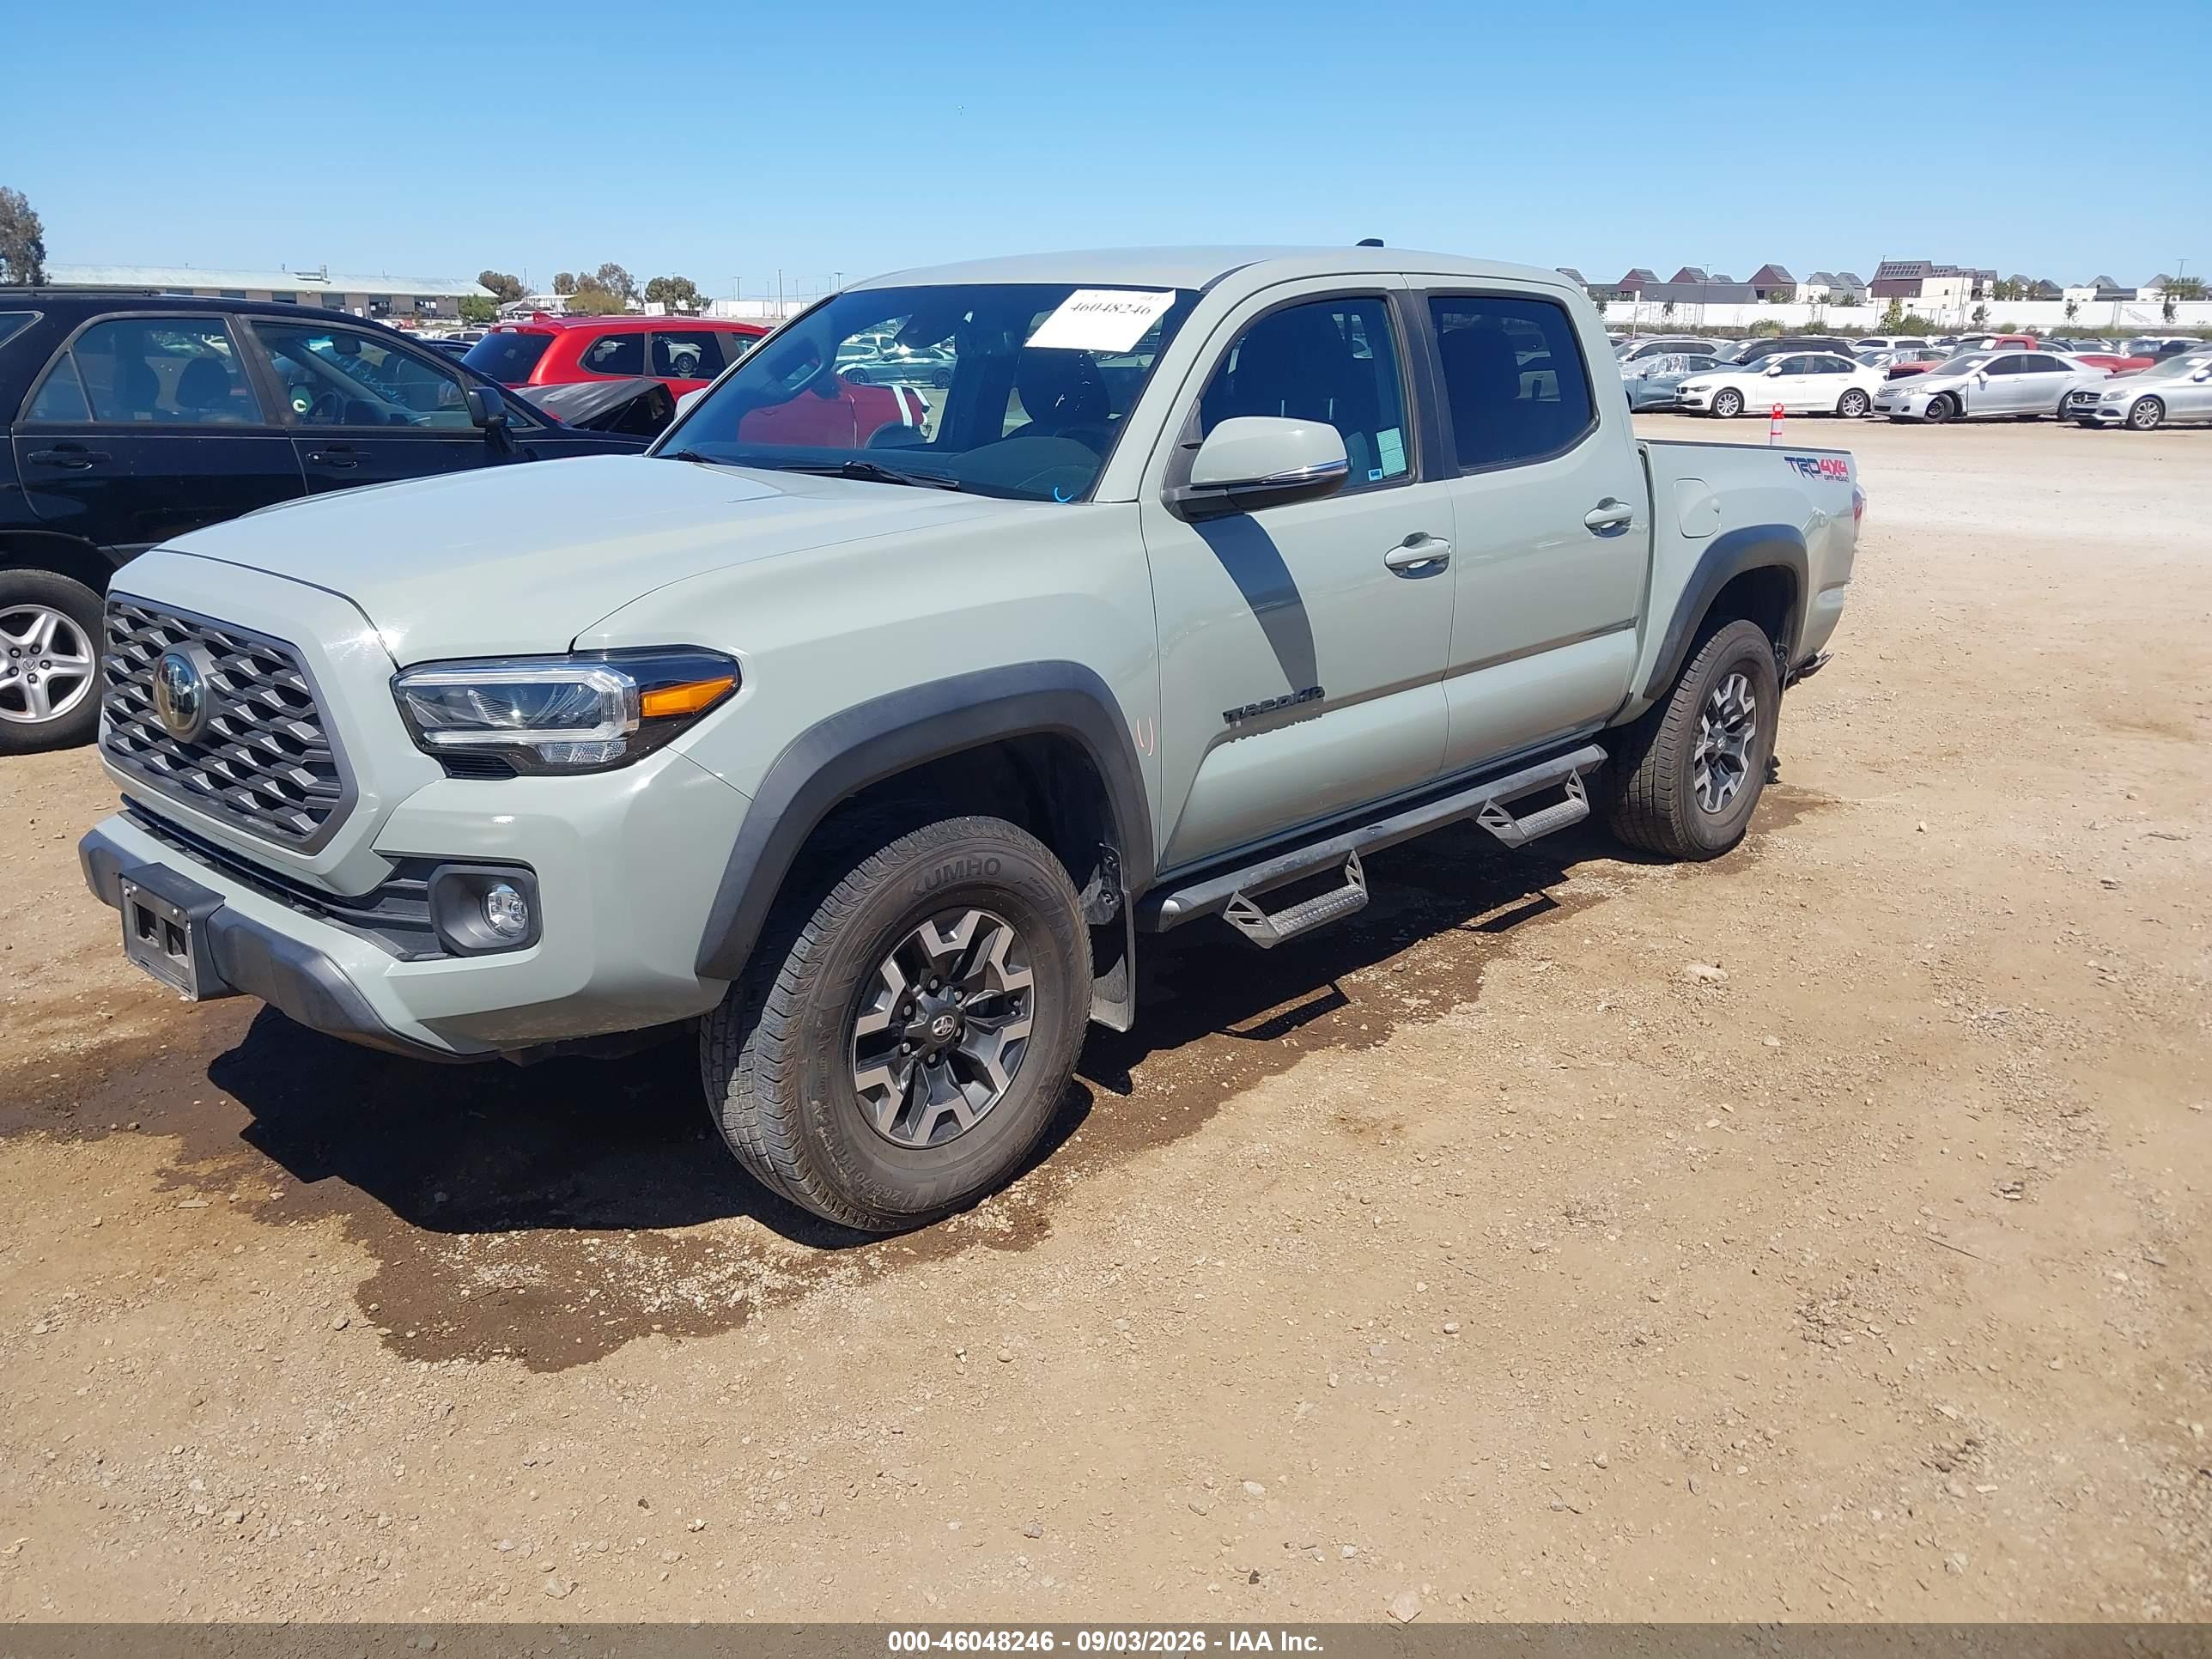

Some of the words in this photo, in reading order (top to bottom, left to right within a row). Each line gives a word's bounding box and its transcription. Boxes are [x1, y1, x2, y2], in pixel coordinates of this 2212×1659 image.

[1070, 302, 1152, 315] 46048246
[1784, 456, 1821, 479] TRD
[1223, 686, 1326, 724] TACOMA
[912, 857, 1001, 896] KUMHO
